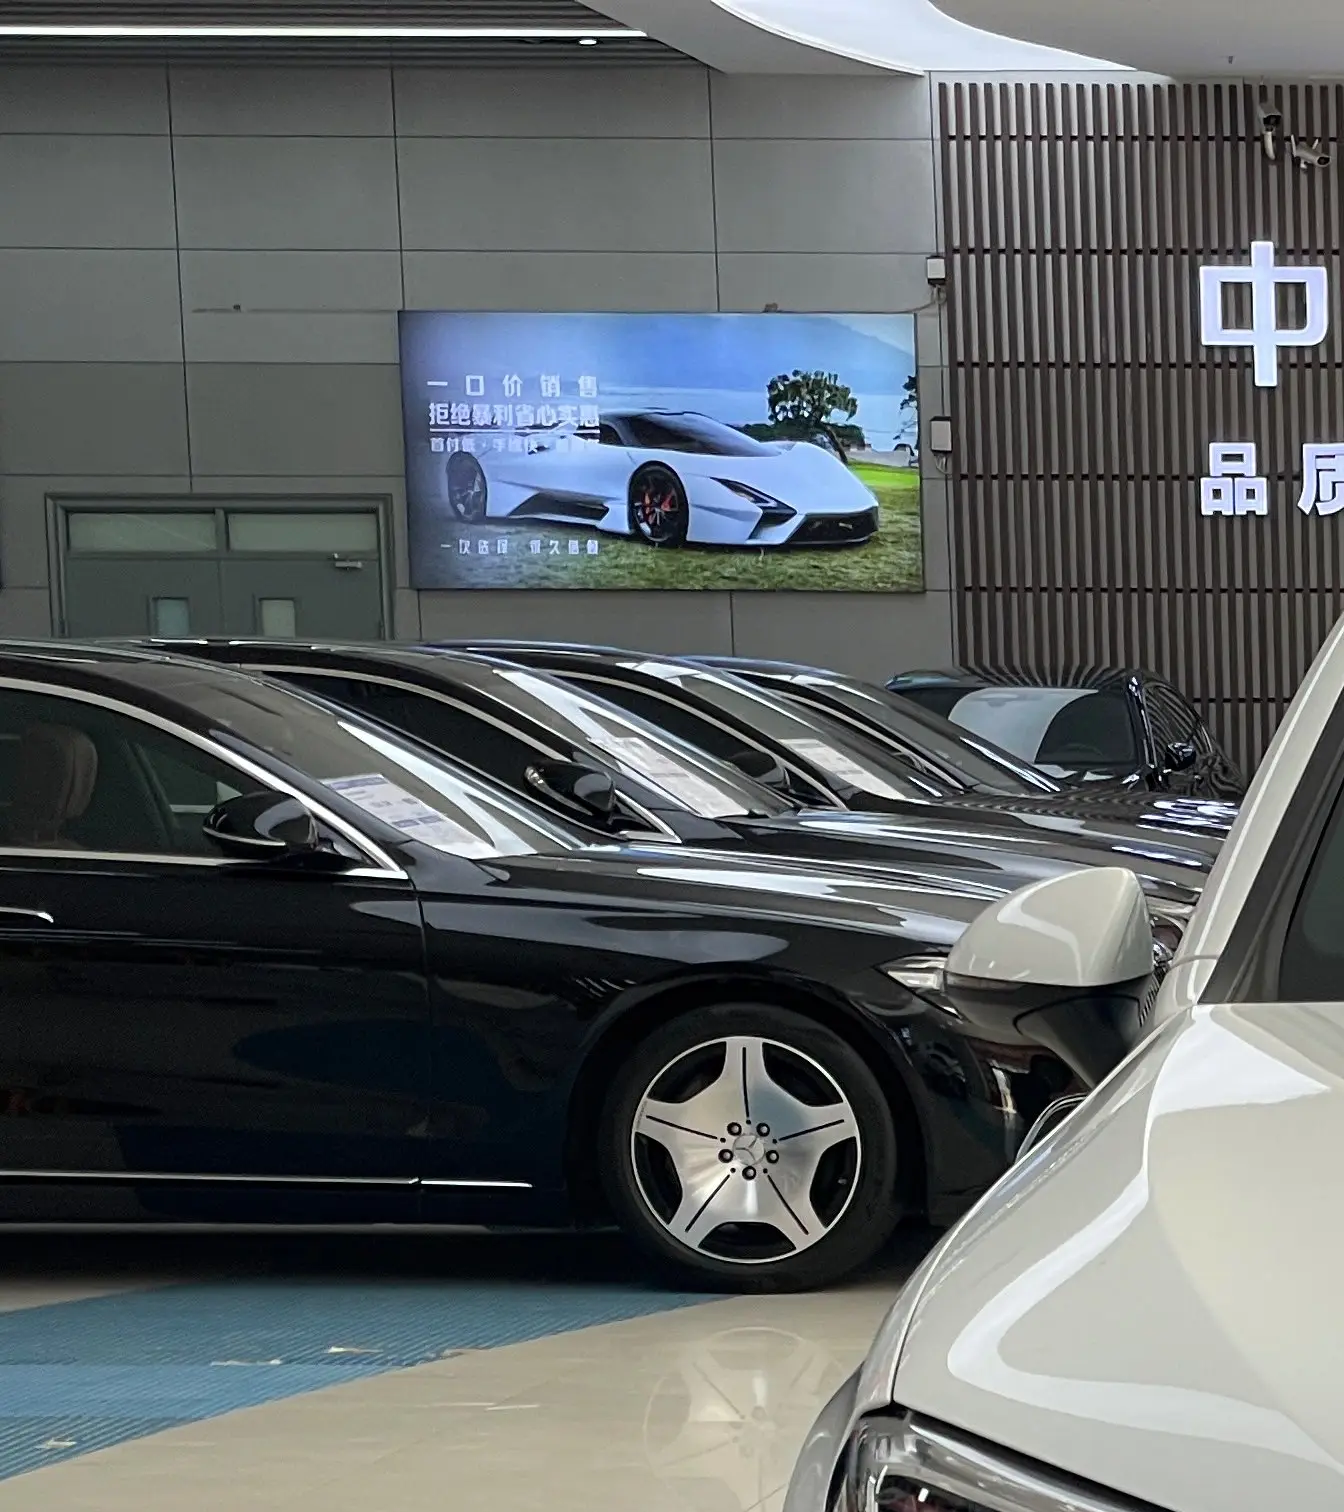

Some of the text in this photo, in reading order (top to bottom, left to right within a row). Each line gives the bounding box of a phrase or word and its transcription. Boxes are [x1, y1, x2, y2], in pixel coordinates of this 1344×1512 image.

[427, 374, 597, 397] 一口价销售
